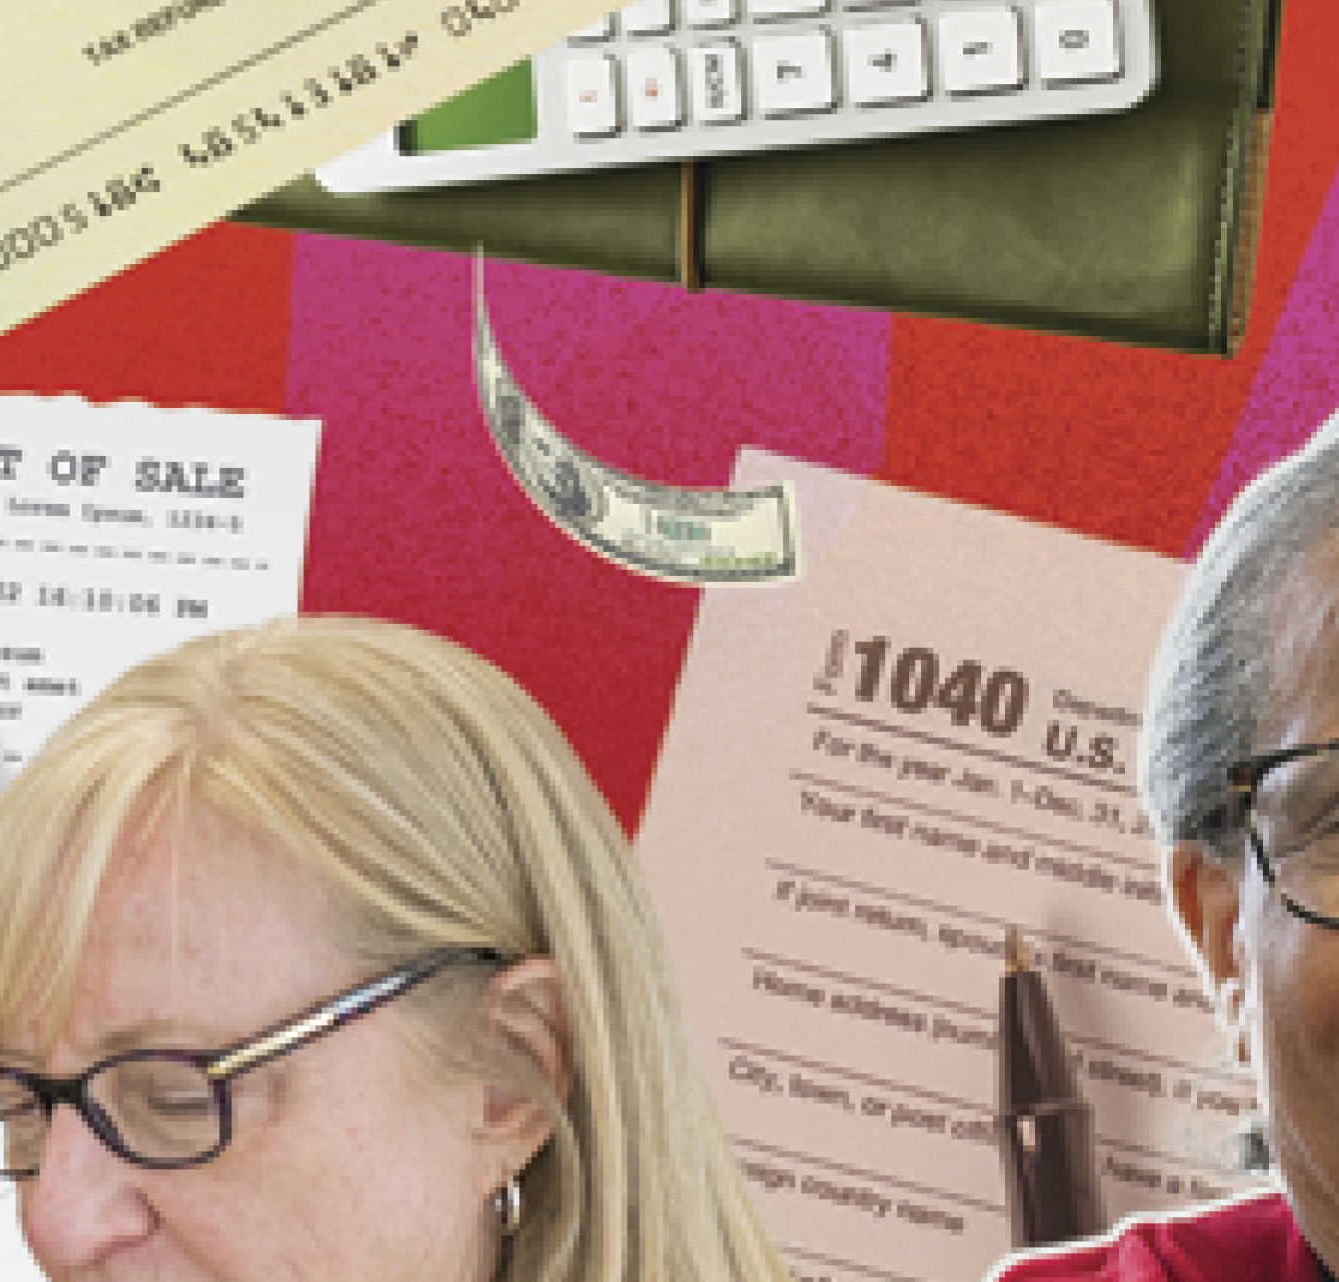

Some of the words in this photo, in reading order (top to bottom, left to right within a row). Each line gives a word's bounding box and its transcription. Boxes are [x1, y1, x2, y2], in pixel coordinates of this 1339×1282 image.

[48, 449, 107, 487] OF
[134, 459, 247, 500] SALE
[853, 634, 1029, 738] 1040
[812, 727, 852, 758] For
[857, 738, 893, 768] the
[897, 753, 951, 788] year
[1044, 723, 1127, 776] U.S.
[799, 789, 856, 825] Your
[861, 802, 910, 838] first
[910, 822, 979, 859] name
[981, 835, 1031, 872] and
[1034, 850, 1116, 893] middle
[752, 967, 825, 1008] Home
[829, 993, 929, 1036] address
[1051, 948, 1097, 984] first
[1099, 968, 1168, 1002] name
[728, 1059, 782, 1097] City,
[787, 1073, 857, 1112] town,
[862, 1095, 888, 1120] or
[890, 1096, 949, 1136] post
[799, 1170, 893, 1219] country
[895, 1199, 966, 1236] name
